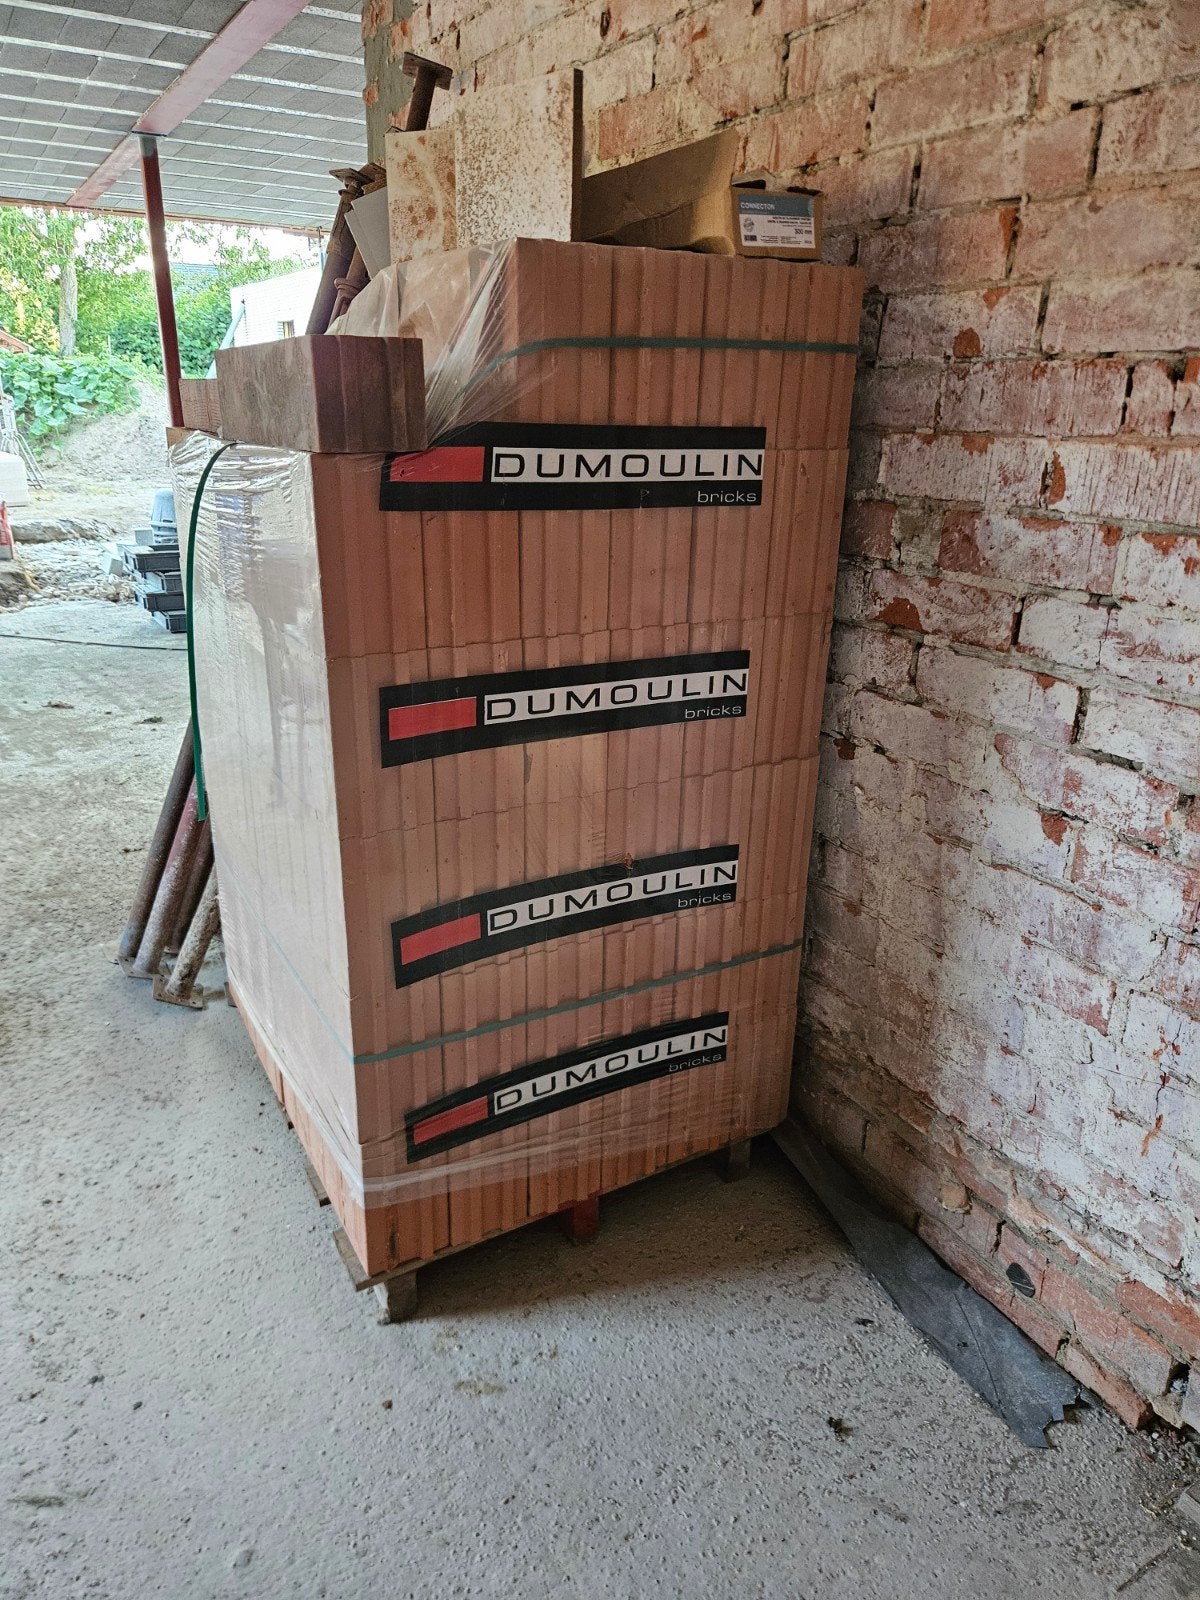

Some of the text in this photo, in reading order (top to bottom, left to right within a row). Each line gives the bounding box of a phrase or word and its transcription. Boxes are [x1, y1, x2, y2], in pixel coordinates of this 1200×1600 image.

[494, 453, 763, 478] DUMOULIN
[697, 490, 757, 504] bricks
[486, 674, 747, 720] DUMOULIN
[684, 705, 742, 720] bricks
[490, 864, 737, 932] DUMOULIN
[677, 891, 732, 909] bricks
[496, 1029, 727, 1110] DUMOULIN
[668, 1053, 722, 1073] bricks
